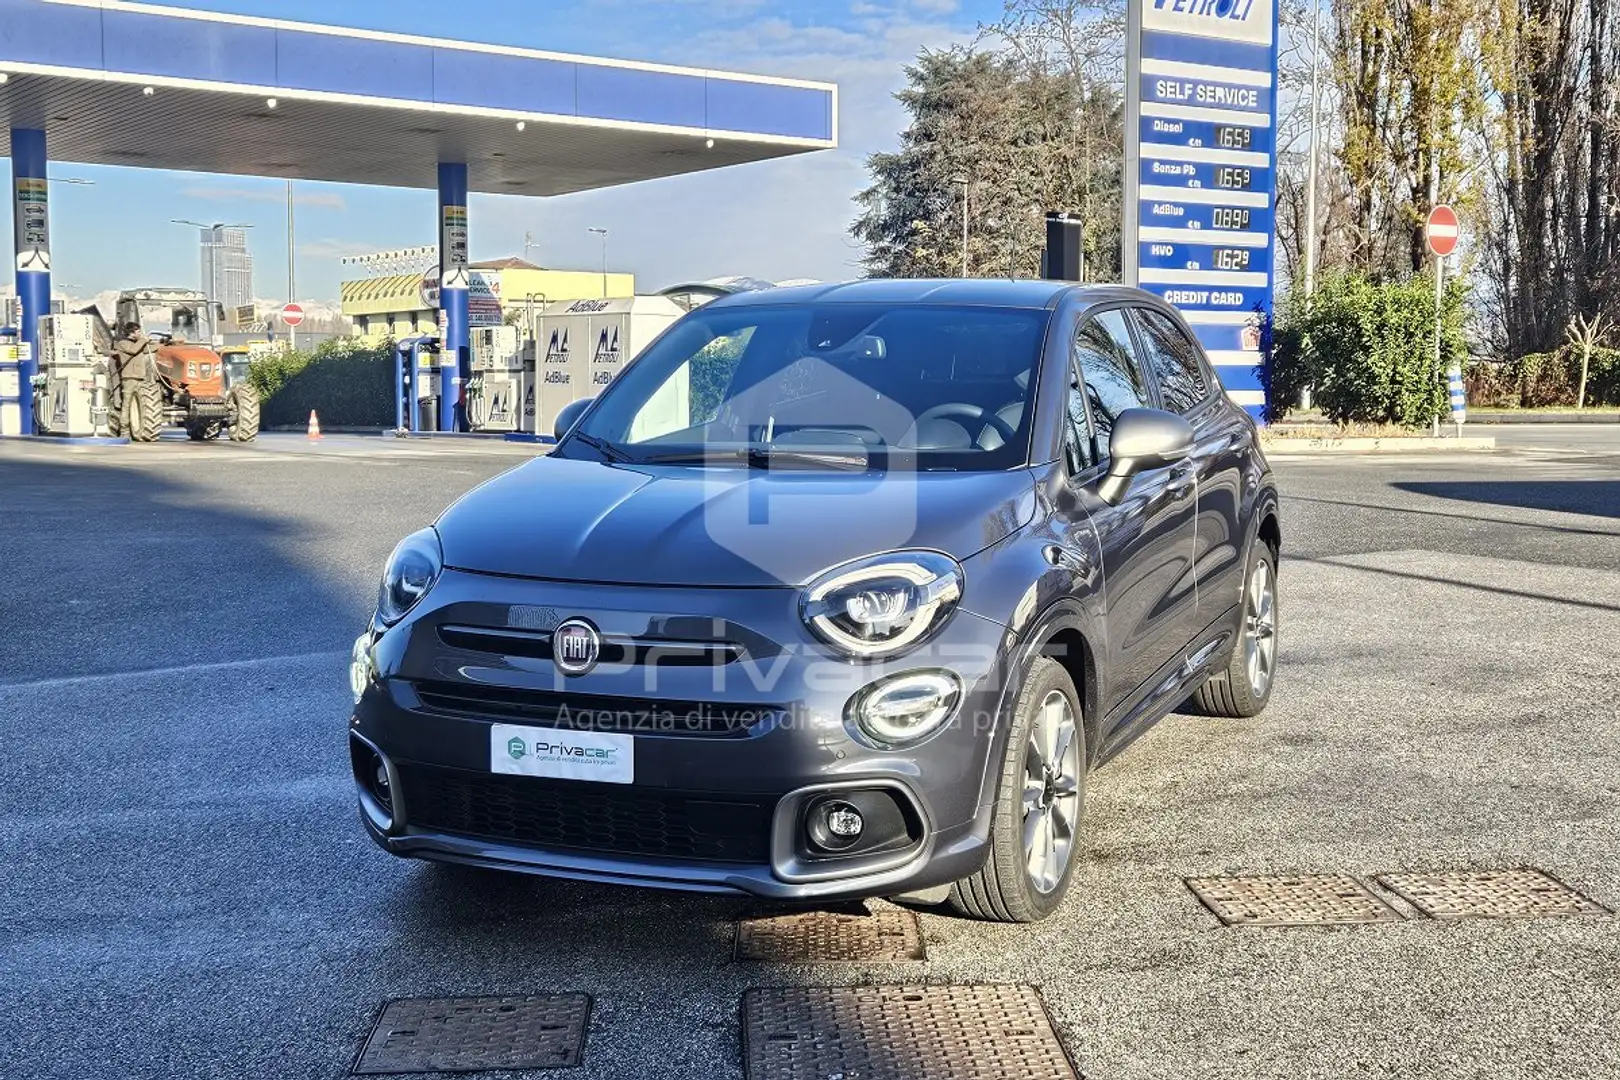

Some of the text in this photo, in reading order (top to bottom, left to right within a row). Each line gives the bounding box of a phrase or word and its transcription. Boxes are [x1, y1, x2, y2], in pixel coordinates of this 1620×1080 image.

[1156, 80, 1258, 107] SELF SERVICE
[1153, 120, 1183, 134] Diesel
[1152, 162, 1196, 176] Senza Pb
[1152, 204, 1184, 216] AdBlue
[1151, 244, 1174, 257] HVO
[1164, 290, 1244, 305] CREDIT CARD
[564, 299, 609, 314] AdBlue
[544, 371, 571, 385] AdBlue
[563, 636, 589, 659] FIAT
[536, 741, 615, 759] Privacar
